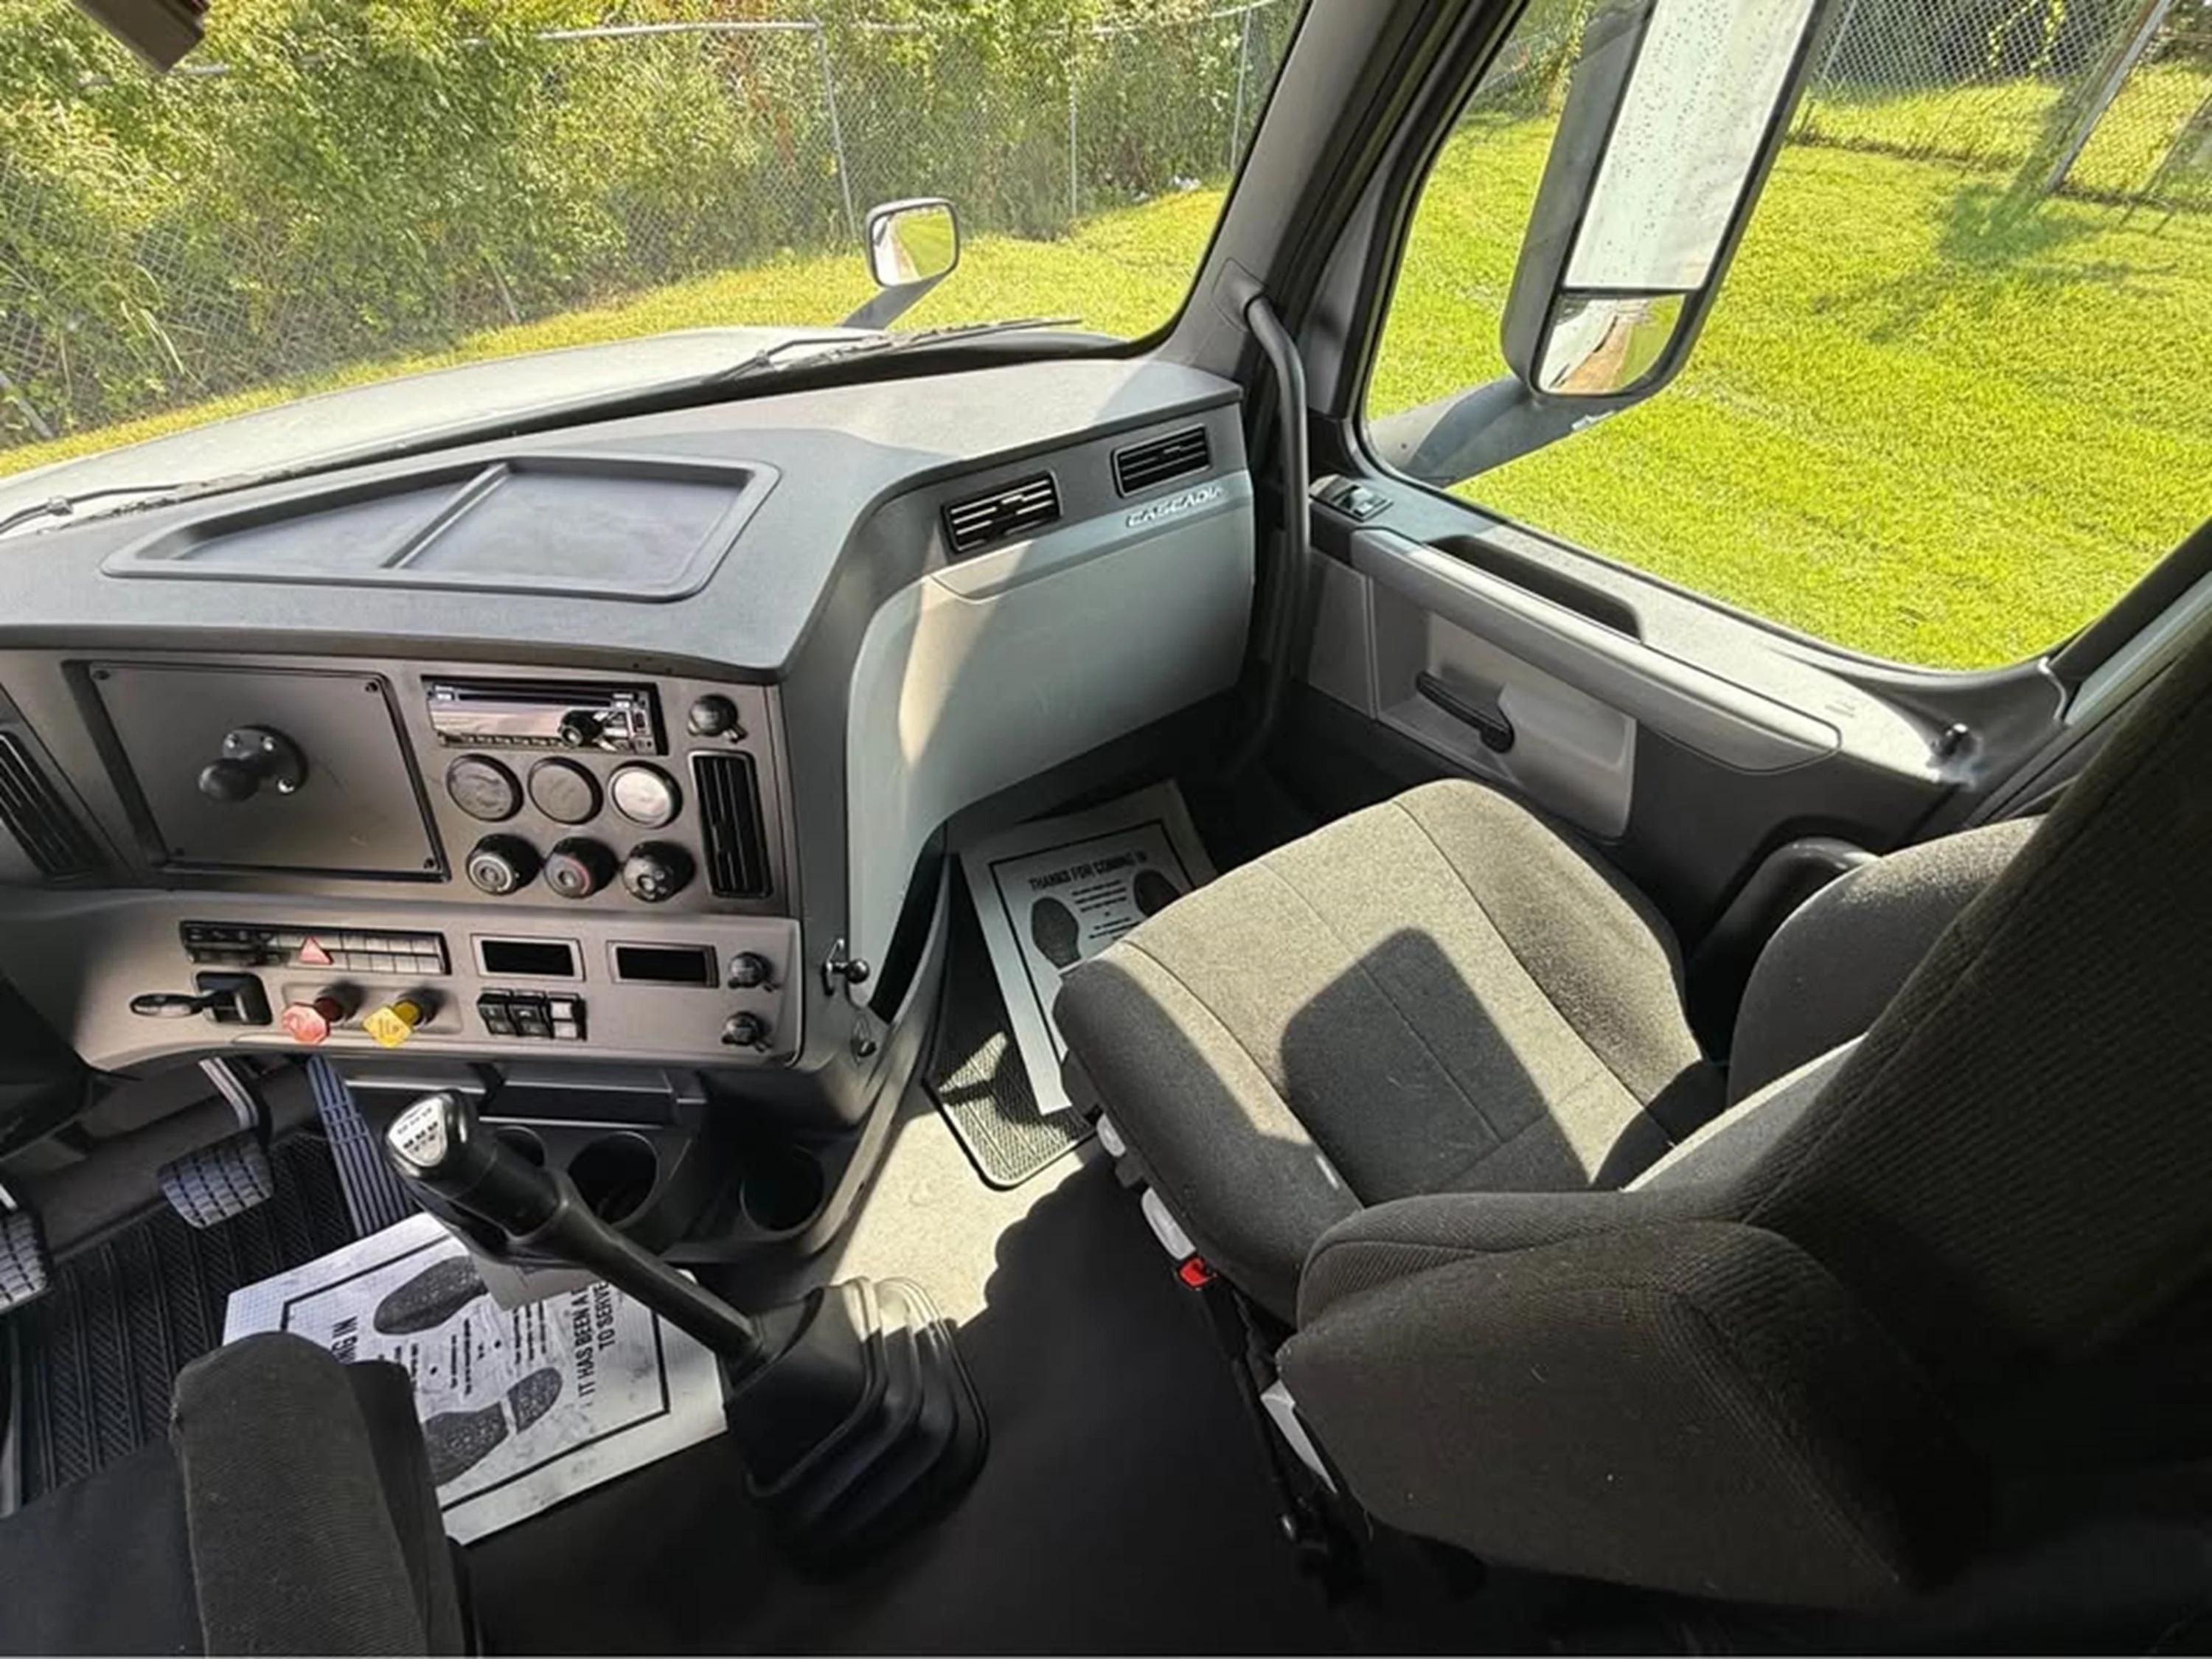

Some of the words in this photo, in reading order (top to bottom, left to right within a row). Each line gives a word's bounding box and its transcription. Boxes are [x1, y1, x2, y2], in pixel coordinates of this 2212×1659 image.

[1071, 862, 1095, 881] FOR
[571, 1293, 590, 1307] A
[593, 1281, 614, 1328] SERVE
[332, 1315, 358, 1339] IN
[572, 1307, 592, 1348] BEEN
[597, 1329, 616, 1352] TO
[575, 1346, 595, 1380] HAS
[578, 1380, 596, 1398] IT
